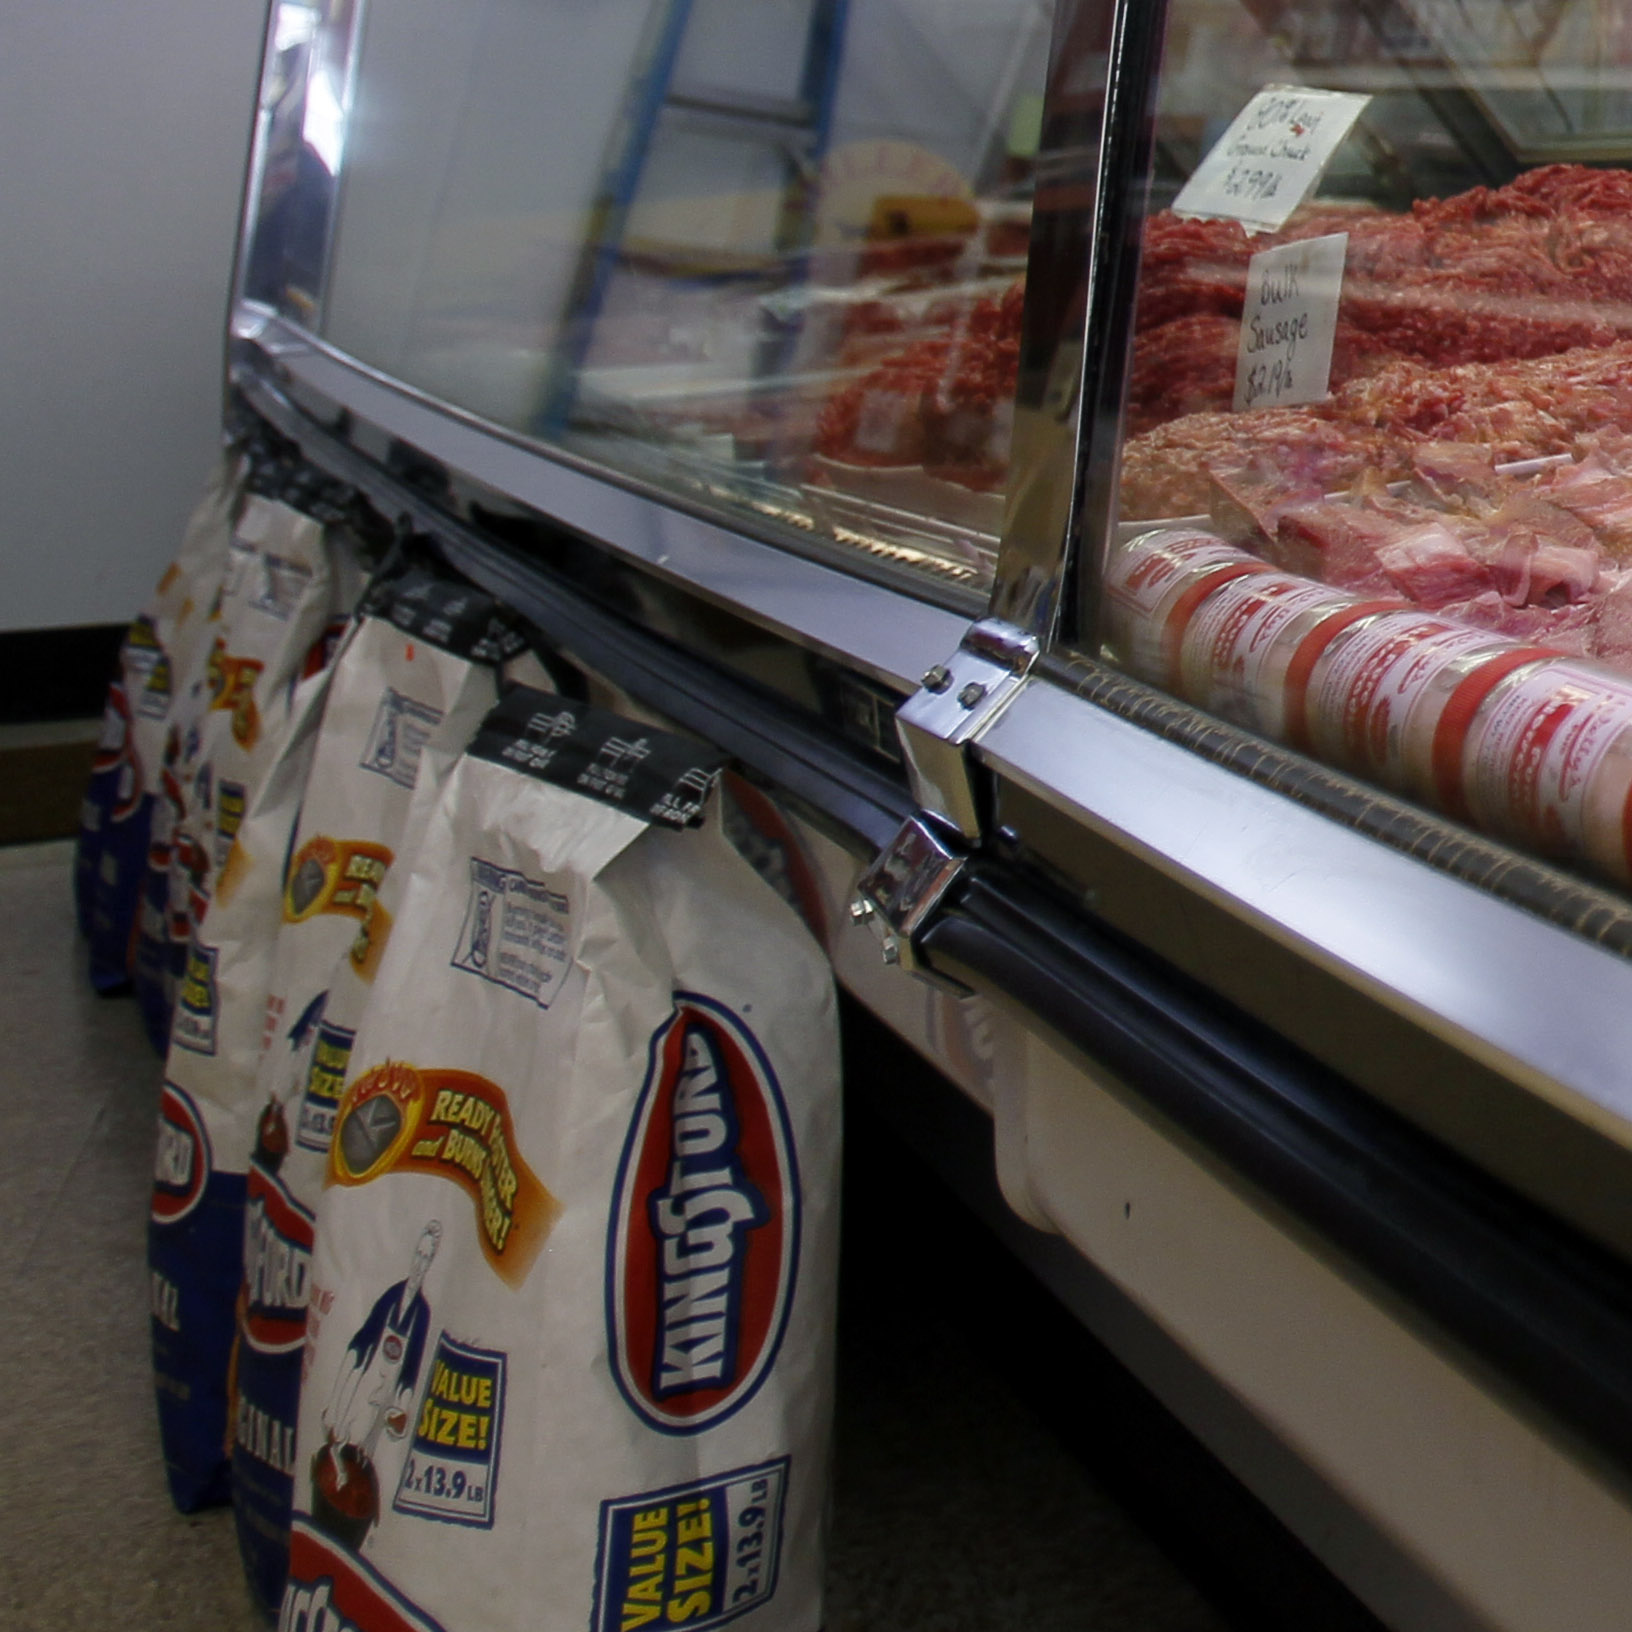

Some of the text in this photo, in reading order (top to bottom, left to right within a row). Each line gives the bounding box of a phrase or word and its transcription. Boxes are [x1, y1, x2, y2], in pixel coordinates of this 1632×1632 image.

[1247, 312, 1308, 364] Sausage
[430, 1089, 494, 1136] READY
[431, 1360, 493, 1409] VALUE
[418, 1398, 491, 1451] SIZE!
[467, 1485, 484, 1502] LB
[751, 1479, 769, 1504] LB
[621, 1507, 668, 1632] VALUE
[667, 1498, 713, 1623] SIZE!
